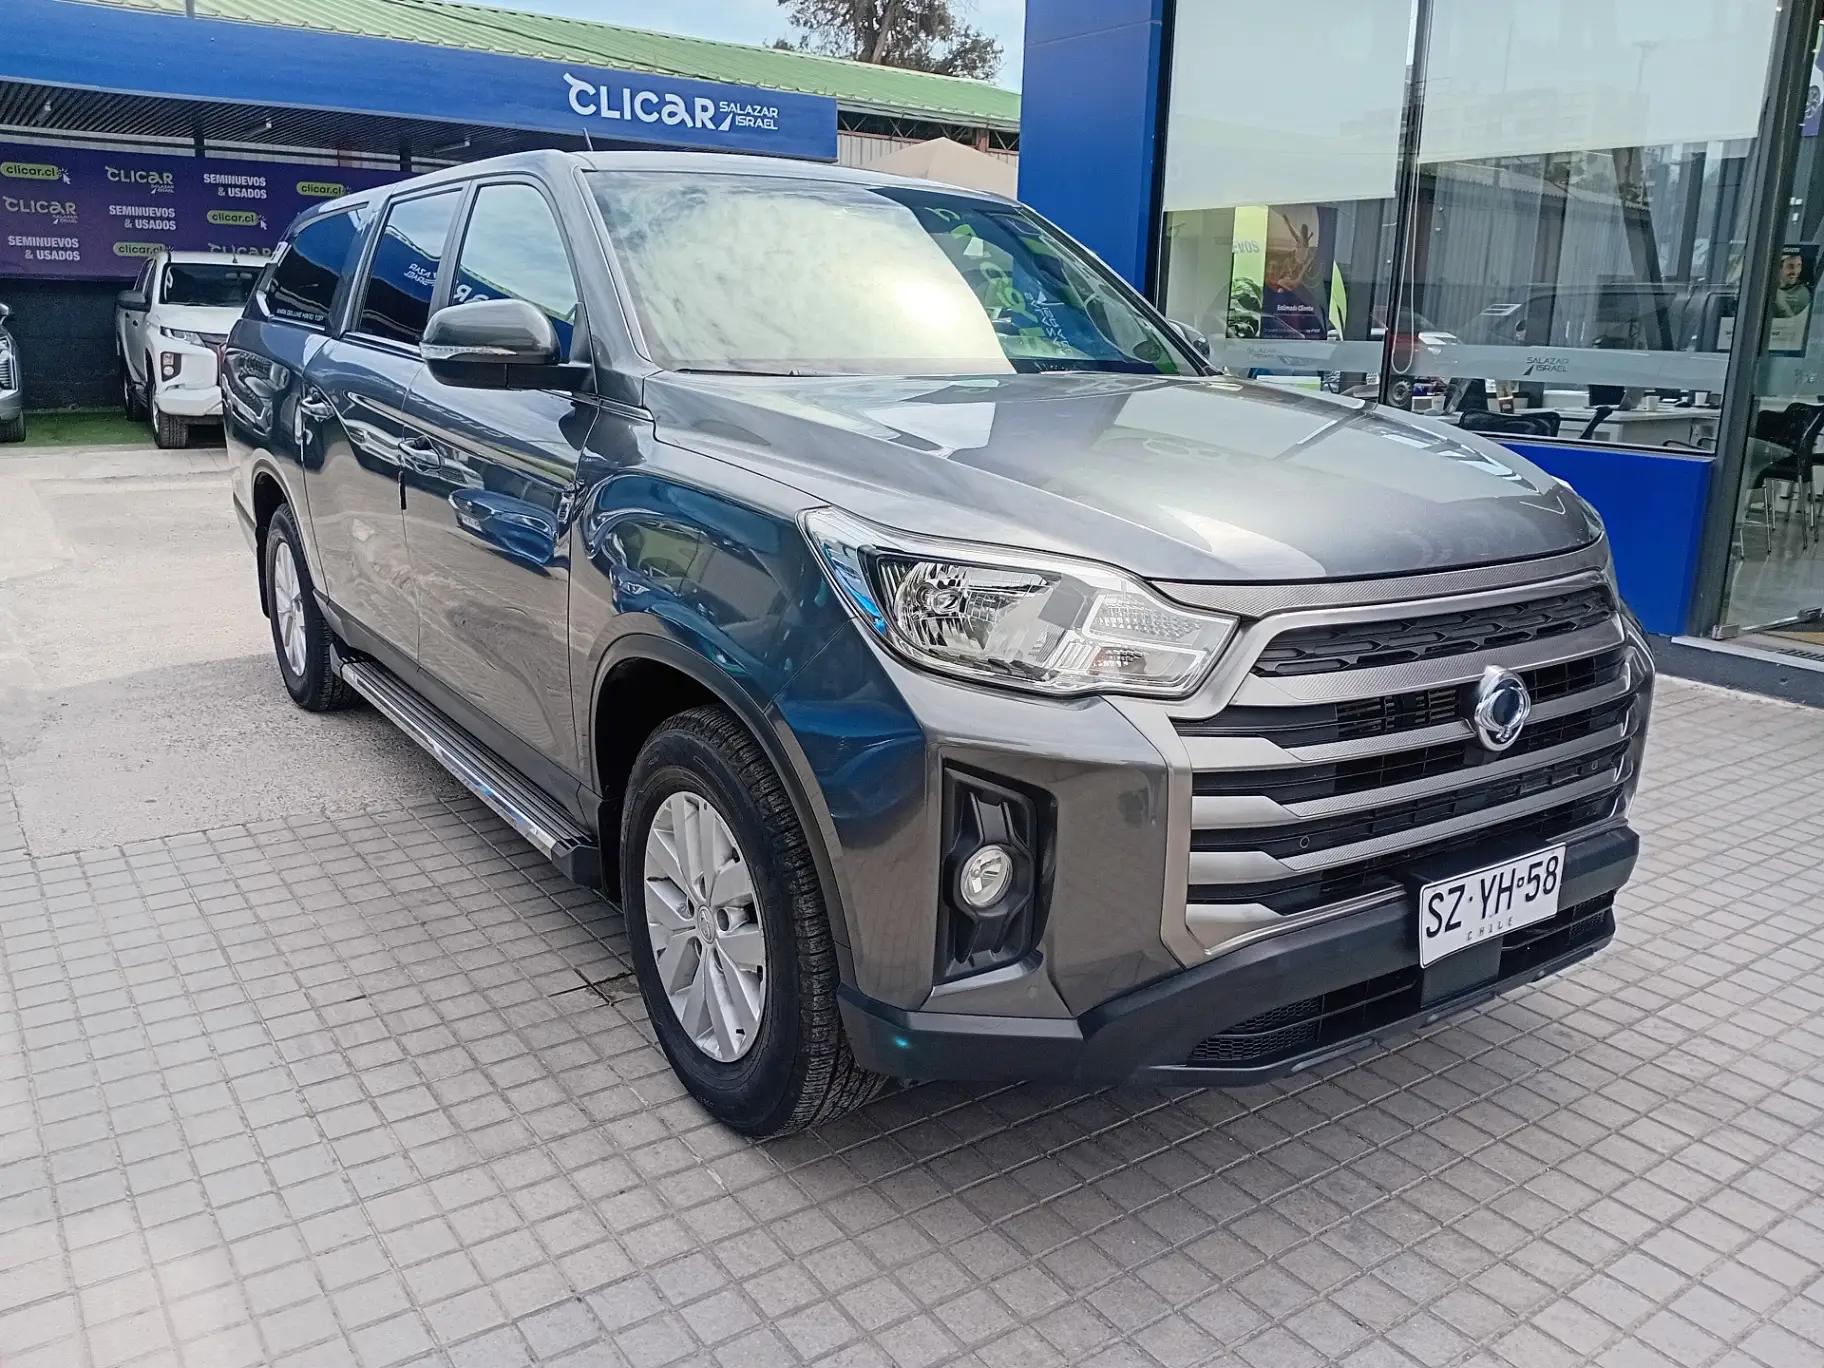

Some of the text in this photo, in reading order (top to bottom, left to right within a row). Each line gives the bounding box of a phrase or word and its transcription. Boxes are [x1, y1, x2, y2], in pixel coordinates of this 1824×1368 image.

[719, 101, 779, 118] SALAZAR
[735, 115, 779, 130] ISRAEL
[6, 165, 55, 177] clicar.cl
[203, 174, 267, 187] SEMINUEVOS
[217, 187, 268, 199] & USADOS
[301, 183, 342, 195] clicar.cl
[108, 205, 176, 218] SEMINUEVOS
[211, 213, 254, 223] clicar.cl
[124, 218, 177, 231] & USADOS
[8, 235, 80, 249] SEMINUEVOS
[25, 250, 81, 261] & USADOS
[1466, 916, 1514, 941] CHILE
